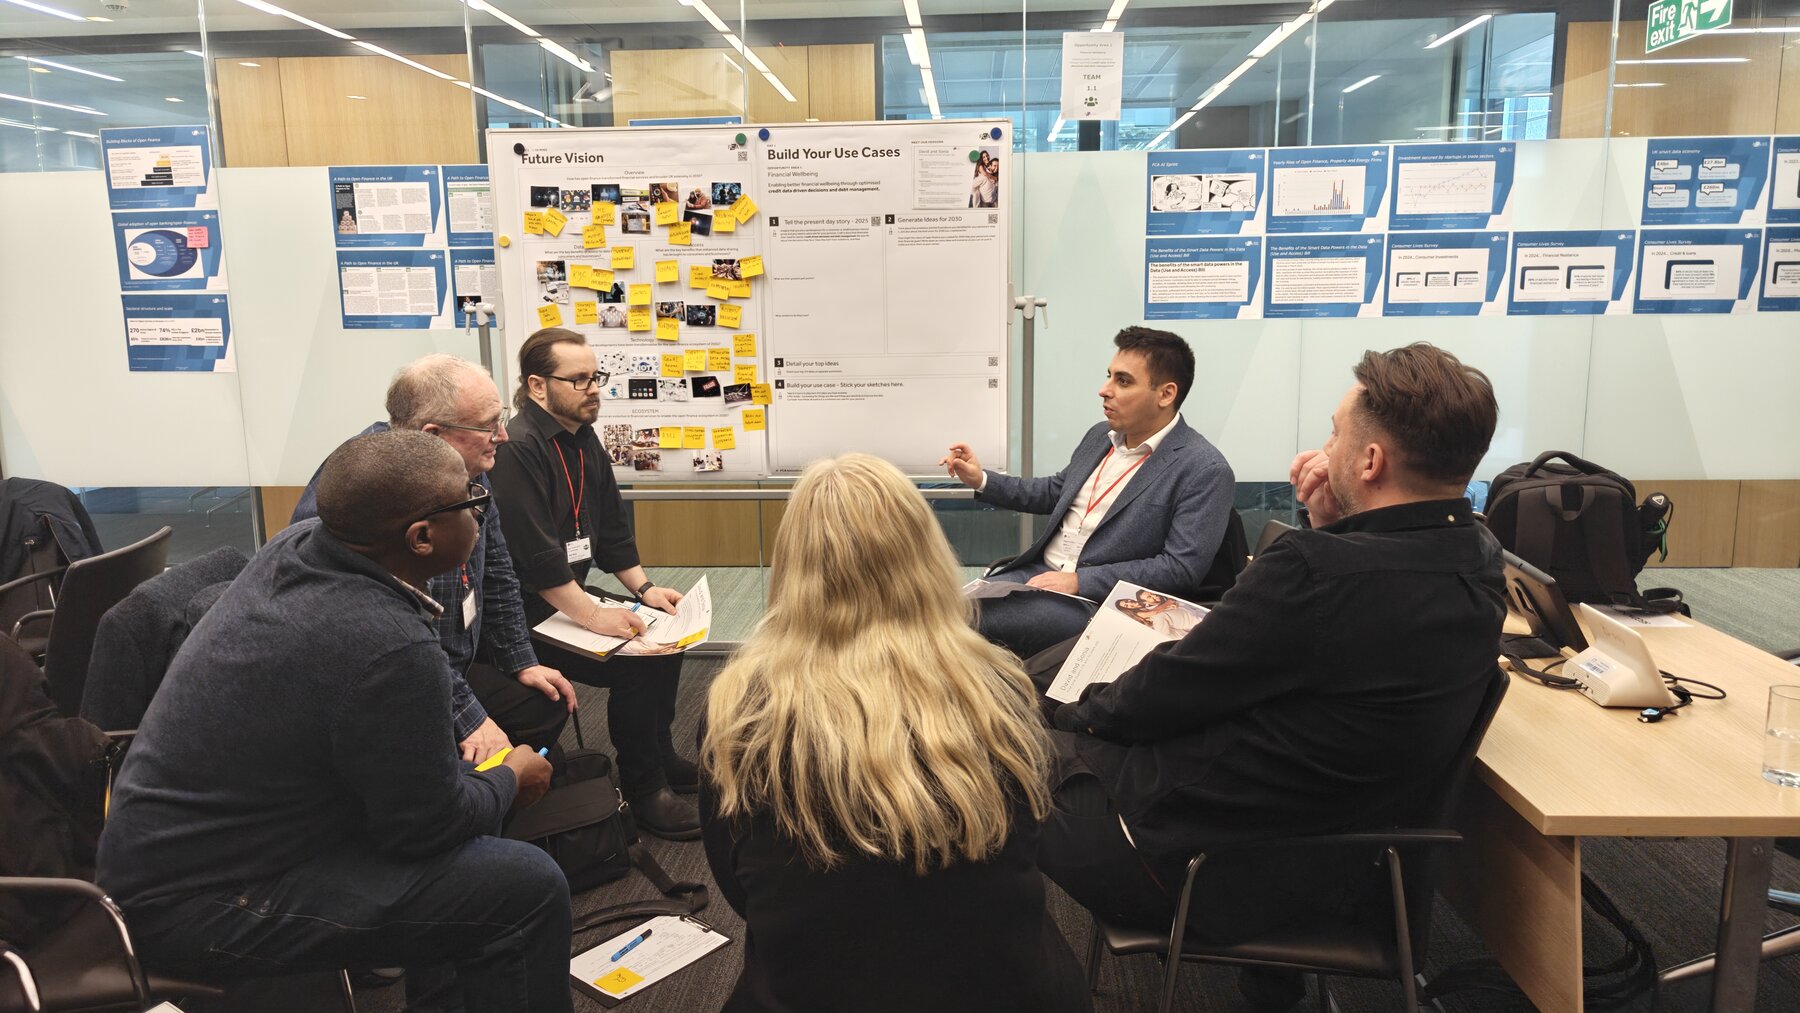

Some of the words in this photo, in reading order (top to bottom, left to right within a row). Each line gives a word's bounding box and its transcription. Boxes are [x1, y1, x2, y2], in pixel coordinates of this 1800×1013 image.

[1652, 4, 1676, 27] Fire
[1650, 21, 1675, 46] exit
[522, 154, 562, 164] Future
[564, 152, 604, 163] Vision
[768, 149, 800, 160] Build
[802, 148, 831, 159] Your
[835, 148, 858, 158] Use
[862, 147, 900, 158] Cases
[1060, 674, 1073, 691] David
[1072, 661, 1080, 673] and
[1078, 647, 1090, 662] Sonia
